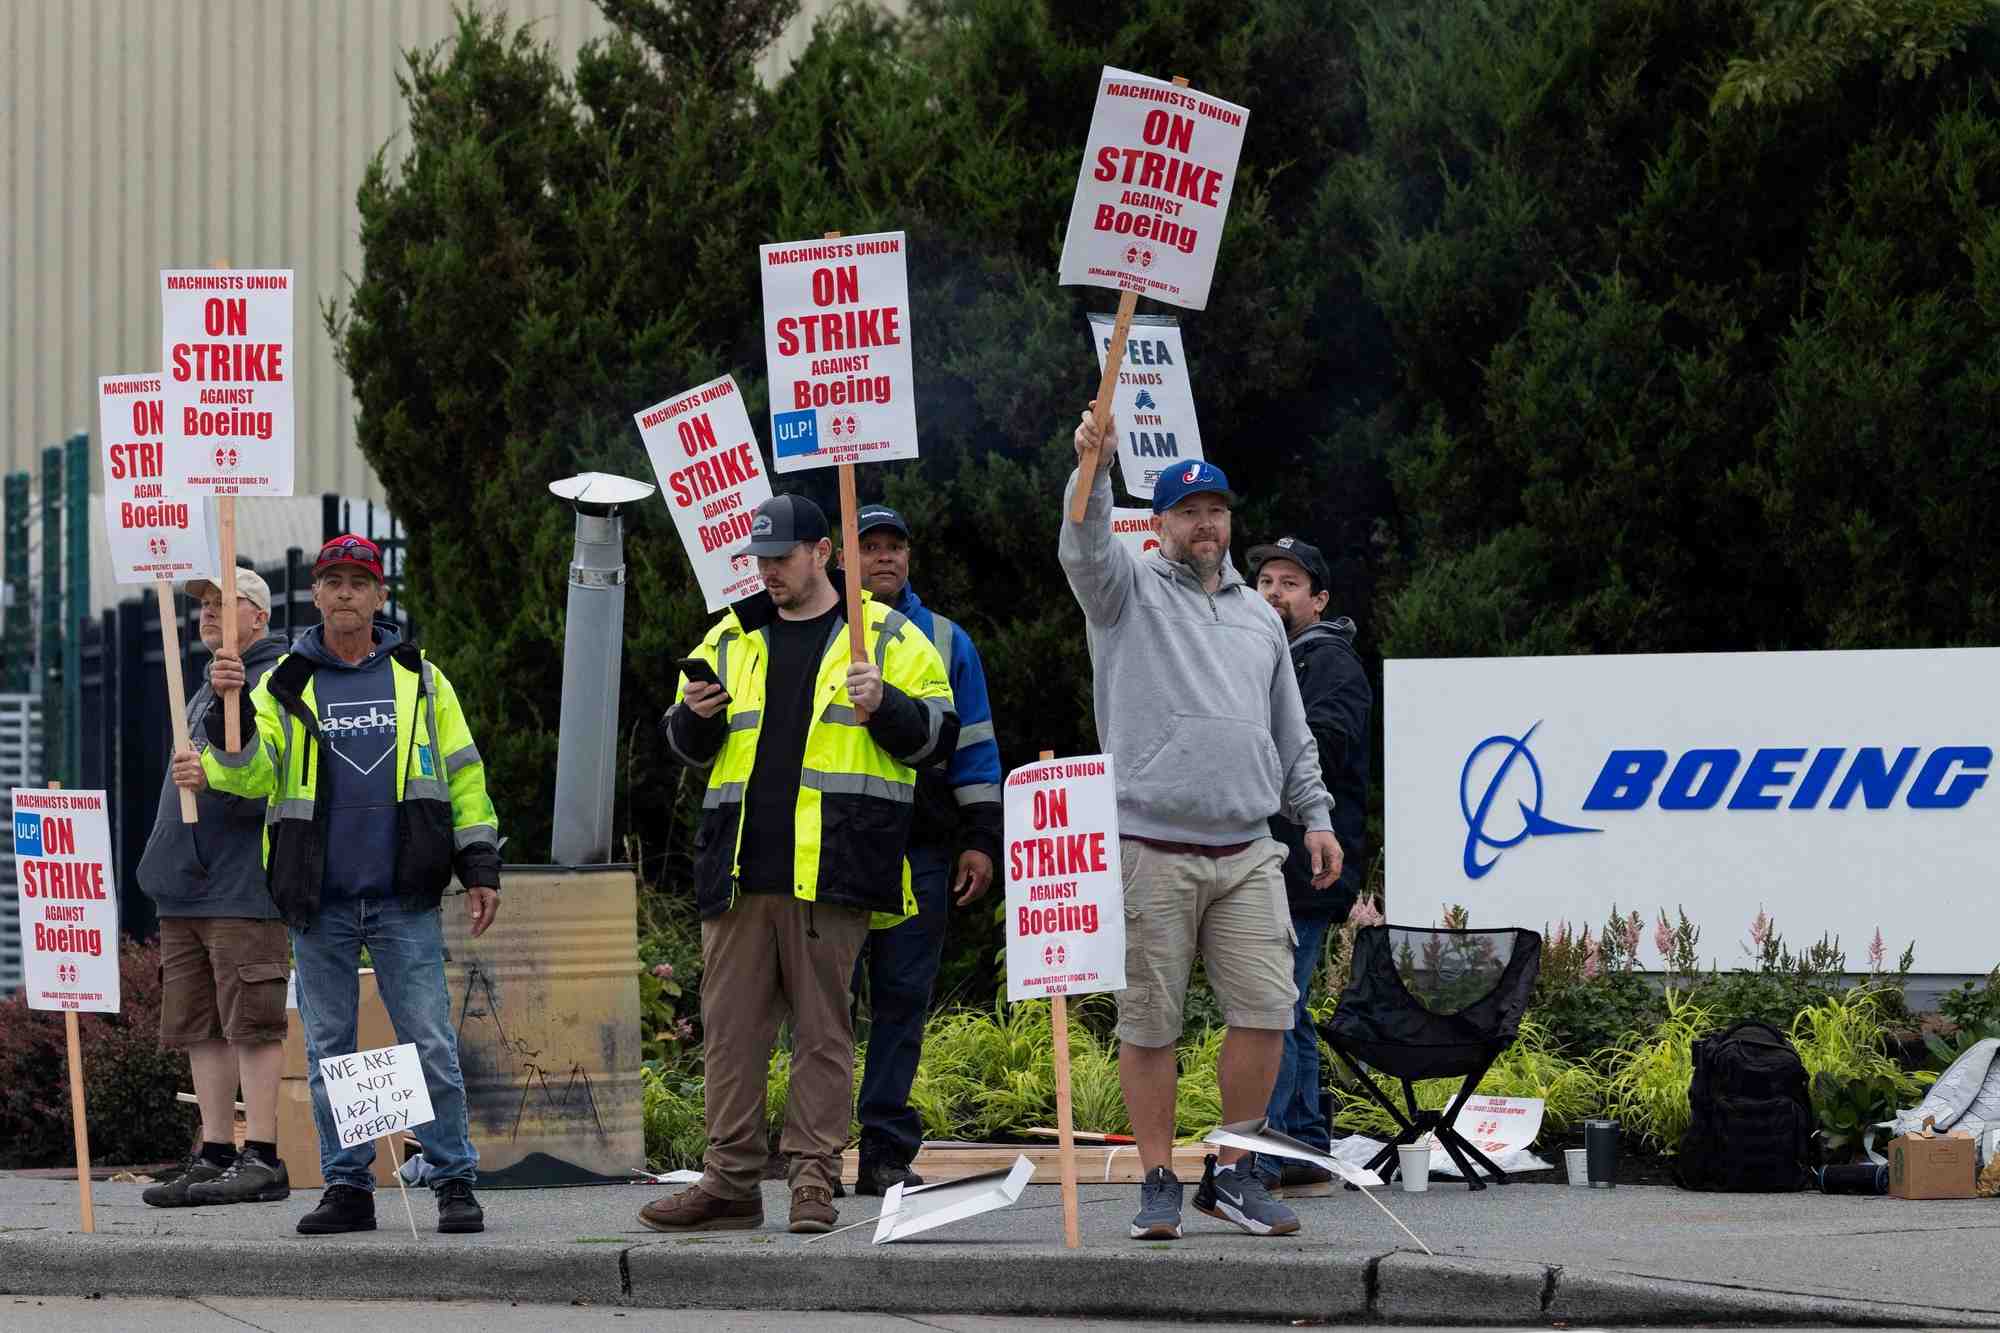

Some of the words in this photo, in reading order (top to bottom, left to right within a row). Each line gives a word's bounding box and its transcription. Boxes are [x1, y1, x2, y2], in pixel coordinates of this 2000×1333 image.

[1106, 84, 1196, 110] MACHINISTS
[1199, 101, 1242, 127] UNION
[1143, 109, 1195, 154] ON
[1094, 146, 1224, 208] STRIKE
[1120, 190, 1183, 217] AGAINST
[1094, 203, 1198, 254] Boeing
[768, 244, 853, 265] MACHINISTS
[856, 239, 899, 256] UNION
[168, 276, 243, 289] MACHINISTS
[247, 276, 287, 289] UNION
[812, 265, 859, 307] ON
[1117, 271, 1147, 285] DISTRICT
[205, 298, 247, 336] ON
[777, 307, 900, 356] STRIKE
[172, 343, 283, 382] STRIKE
[812, 354, 869, 376] AGAINST
[1104, 337, 1173, 365] EEA
[104, 380, 161, 395] MACHINISTS
[794, 375, 891, 409] Boeing
[1119, 372, 1163, 385] STANDS
[200, 389, 254, 404] AGAINST
[642, 394, 701, 429] MACHINISTS
[701, 381, 734, 403] UNION
[133, 400, 163, 436] ON
[184, 406, 273, 440] Boeing
[778, 418, 813, 440] ULP!
[1134, 414, 1162, 425] WITH
[678, 412, 718, 458] ON
[829, 445, 858, 454] DISTRICT
[1130, 432, 1179, 457] IAM
[110, 442, 163, 479] STRI
[669, 442, 760, 507] STRIKE
[134, 484, 162, 498] AGAIN
[703, 492, 743, 519] AGAINST
[121, 501, 189, 529] Boeing
[698, 504, 759, 553] Boein
[1112, 519, 1154, 533] ACHIN
[318, 707, 397, 731] aseba
[1008, 766, 1063, 787] MACHINISTS
[1066, 762, 1105, 778] UNION
[1582, 746, 1993, 811] BOEING
[16, 795, 68, 809] MACHINISTS
[70, 796, 101, 810] UNION
[1033, 788, 1068, 831] ON
[17, 822, 39, 840] ULP!
[43, 817, 75, 855] ON
[1010, 832, 1107, 881] STRIKE
[24, 860, 106, 899] STRIKE
[1030, 882, 1077, 901] AGAINST
[46, 905, 84, 921] AGAINST
[1018, 902, 1099, 936] Boeing
[35, 923, 102, 956] Boeing
[323, 1057, 358, 1080] WE
[364, 1049, 398, 1070] ARE
[356, 1072, 397, 1092] NOT
[335, 1095, 380, 1124] LAZY
[392, 1089, 413, 1102] OR
[343, 1108, 408, 1143] GREEDY
